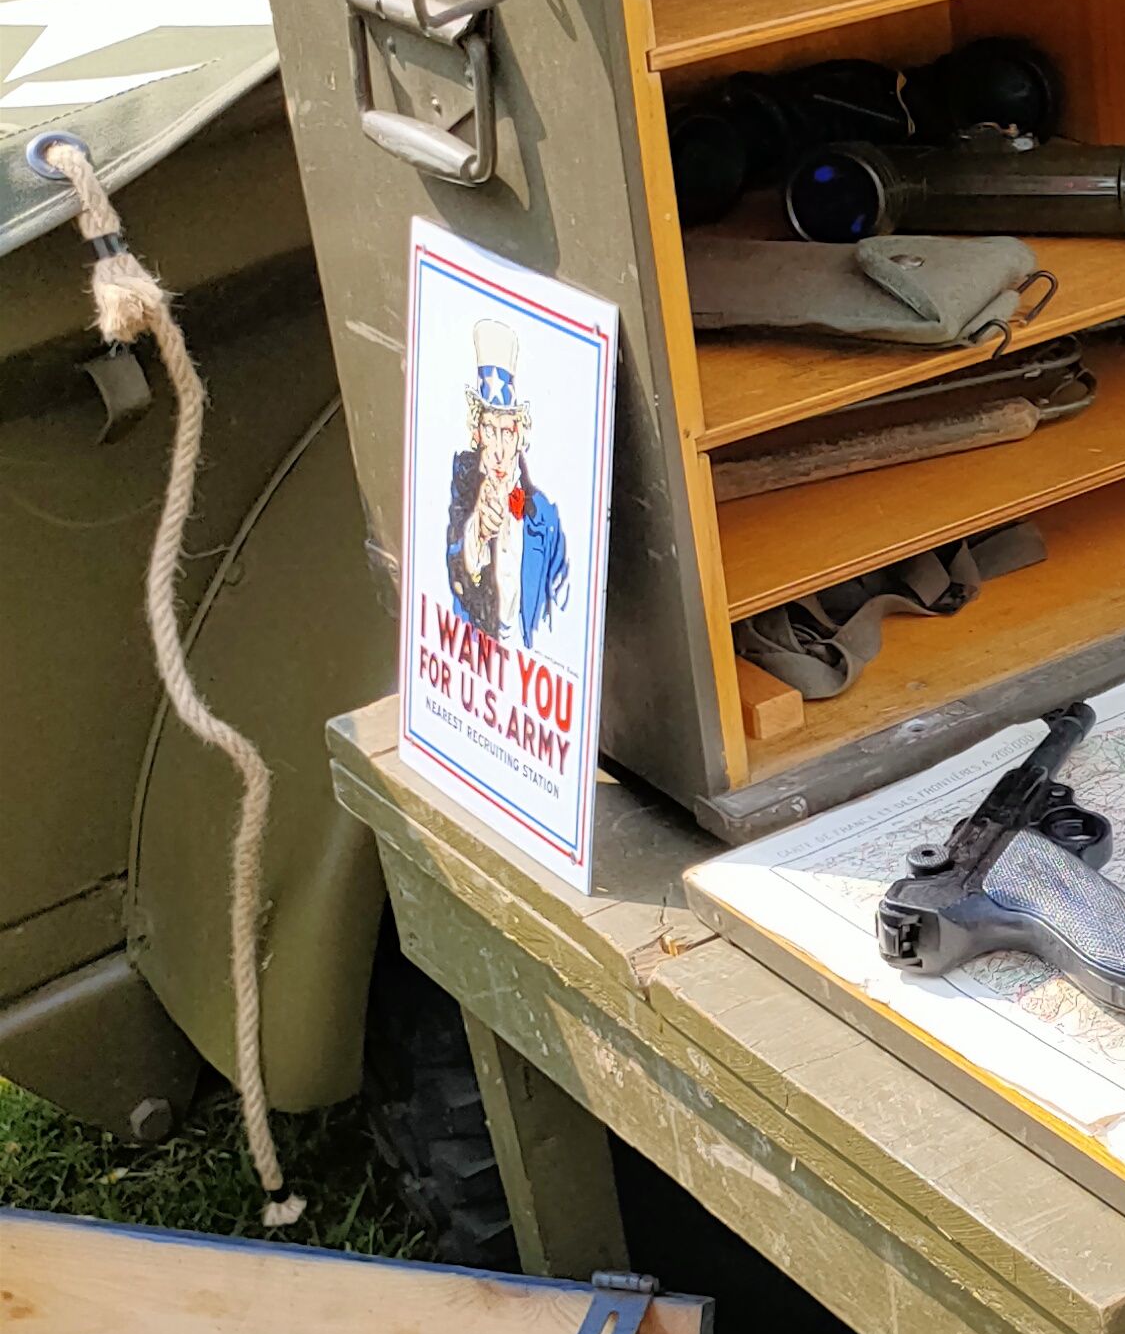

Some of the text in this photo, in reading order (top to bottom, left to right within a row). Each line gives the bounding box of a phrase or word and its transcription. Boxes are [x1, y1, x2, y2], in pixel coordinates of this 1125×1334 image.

[419, 644, 571, 776] FOR U.S. ARMY
[421, 593, 573, 734] I WANT YOU
[426, 696, 560, 800] NEAREST RECRUITING STATION
